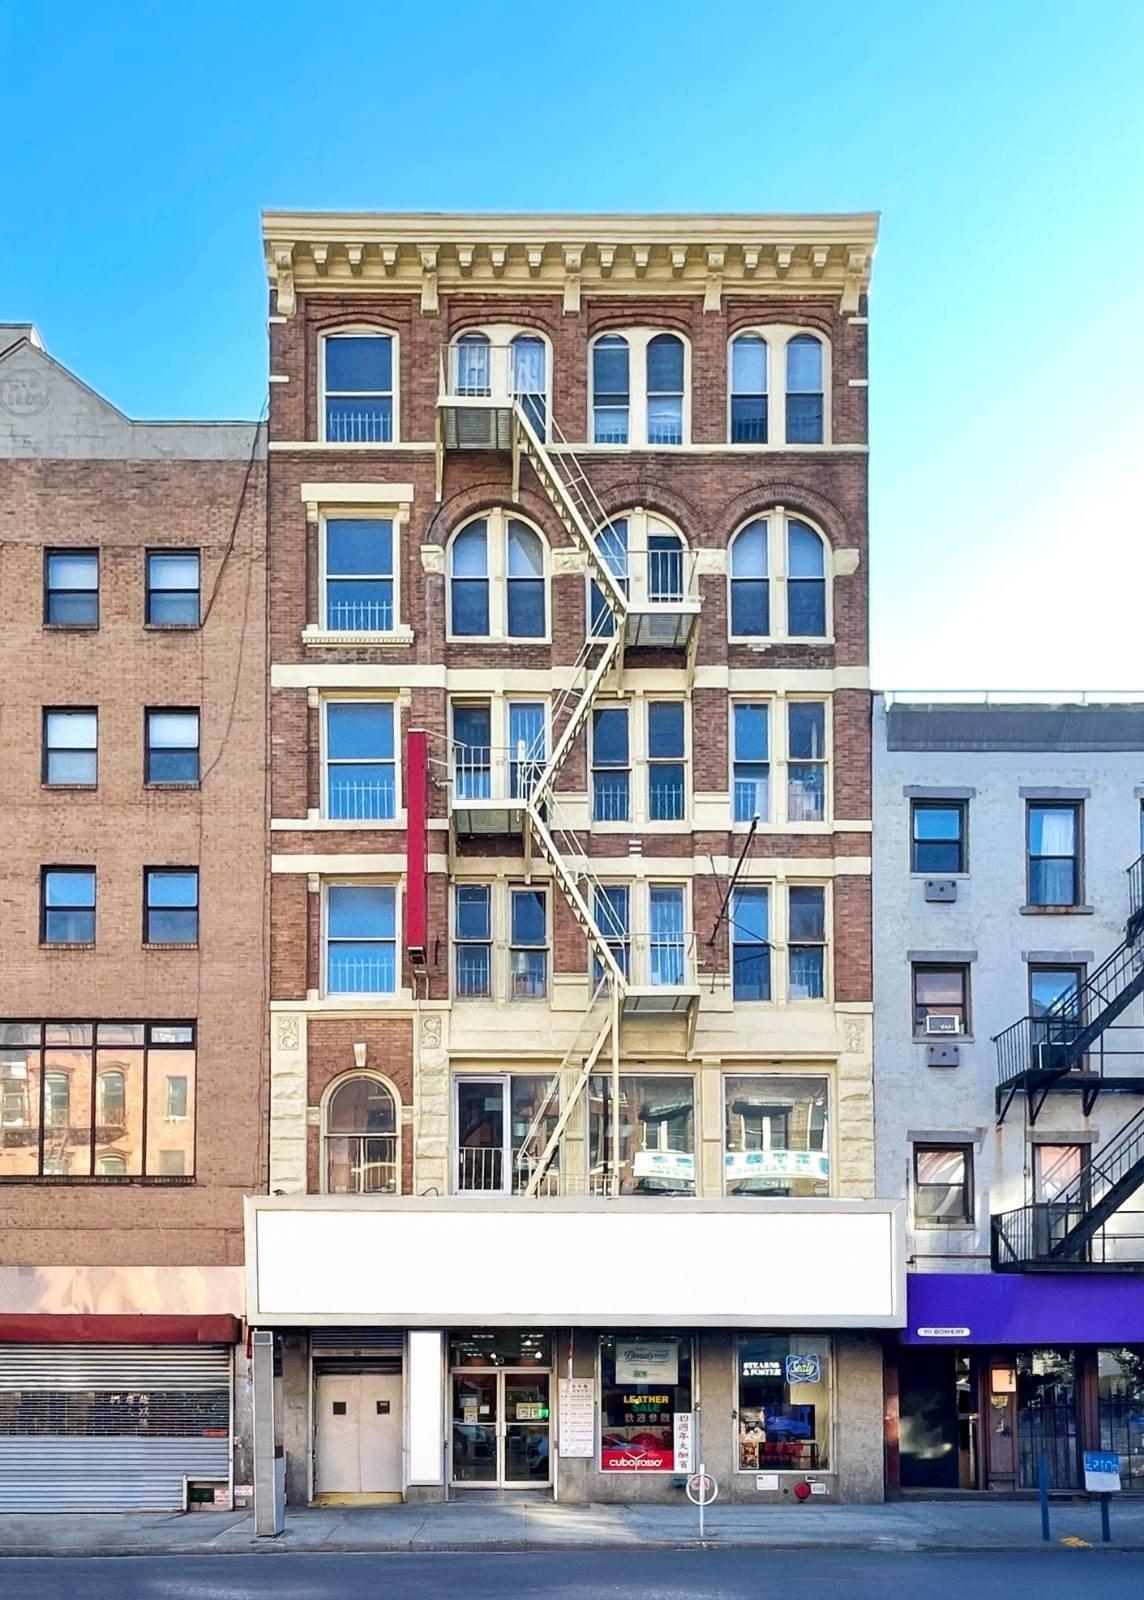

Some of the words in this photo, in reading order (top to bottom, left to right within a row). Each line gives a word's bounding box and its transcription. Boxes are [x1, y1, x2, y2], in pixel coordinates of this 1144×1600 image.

[790, 1361, 815, 1376] Sealy
[623, 1395, 669, 1404] LEATHER
[632, 1404, 661, 1412] SALE
